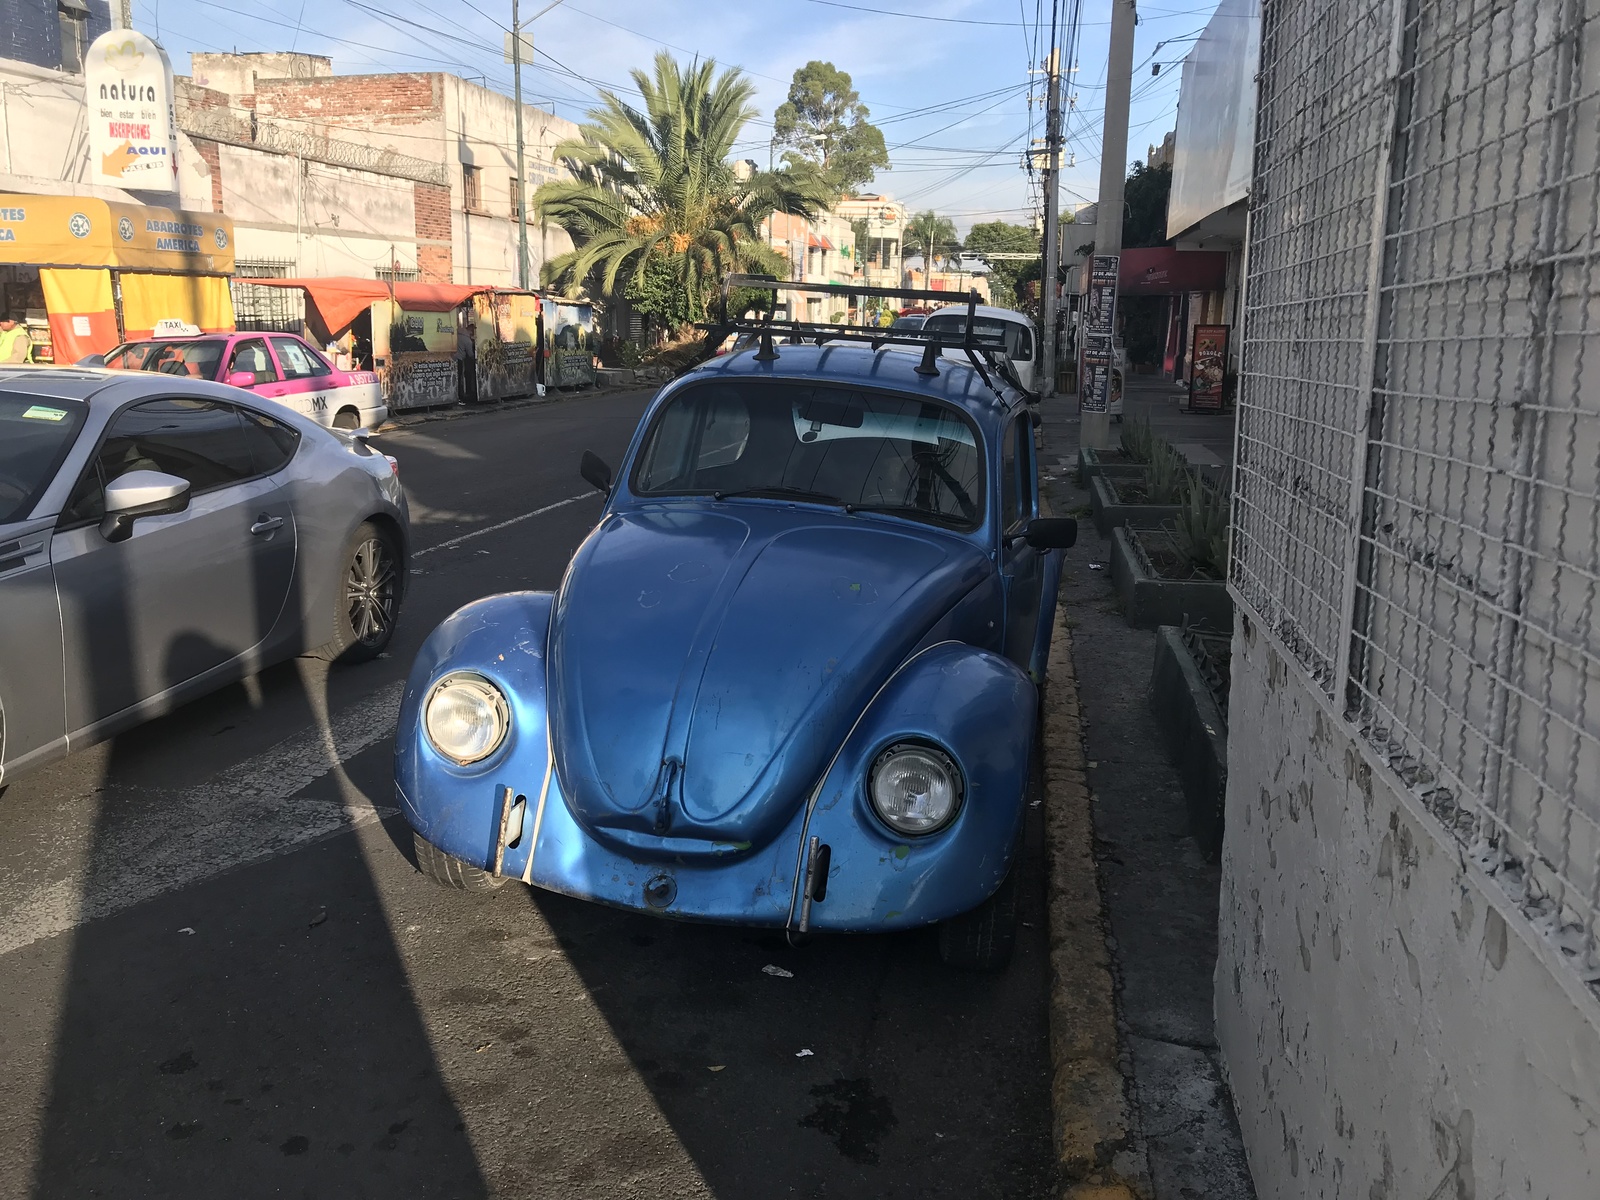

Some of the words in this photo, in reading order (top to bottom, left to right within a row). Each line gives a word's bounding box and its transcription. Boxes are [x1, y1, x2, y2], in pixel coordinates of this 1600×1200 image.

[100, 79, 155, 102] natura
[100, 109, 112, 118] bien
[120, 110, 134, 119] estar
[141, 109, 156, 120] bien
[126, 147, 167, 155] AQUI
[0, 208, 25, 221] TES
[146, 219, 204, 237] ABARROTES
[156, 238, 200, 252] AMERICA
[164, 321, 182, 329] TAXI
[348, 376, 355, 386] A
